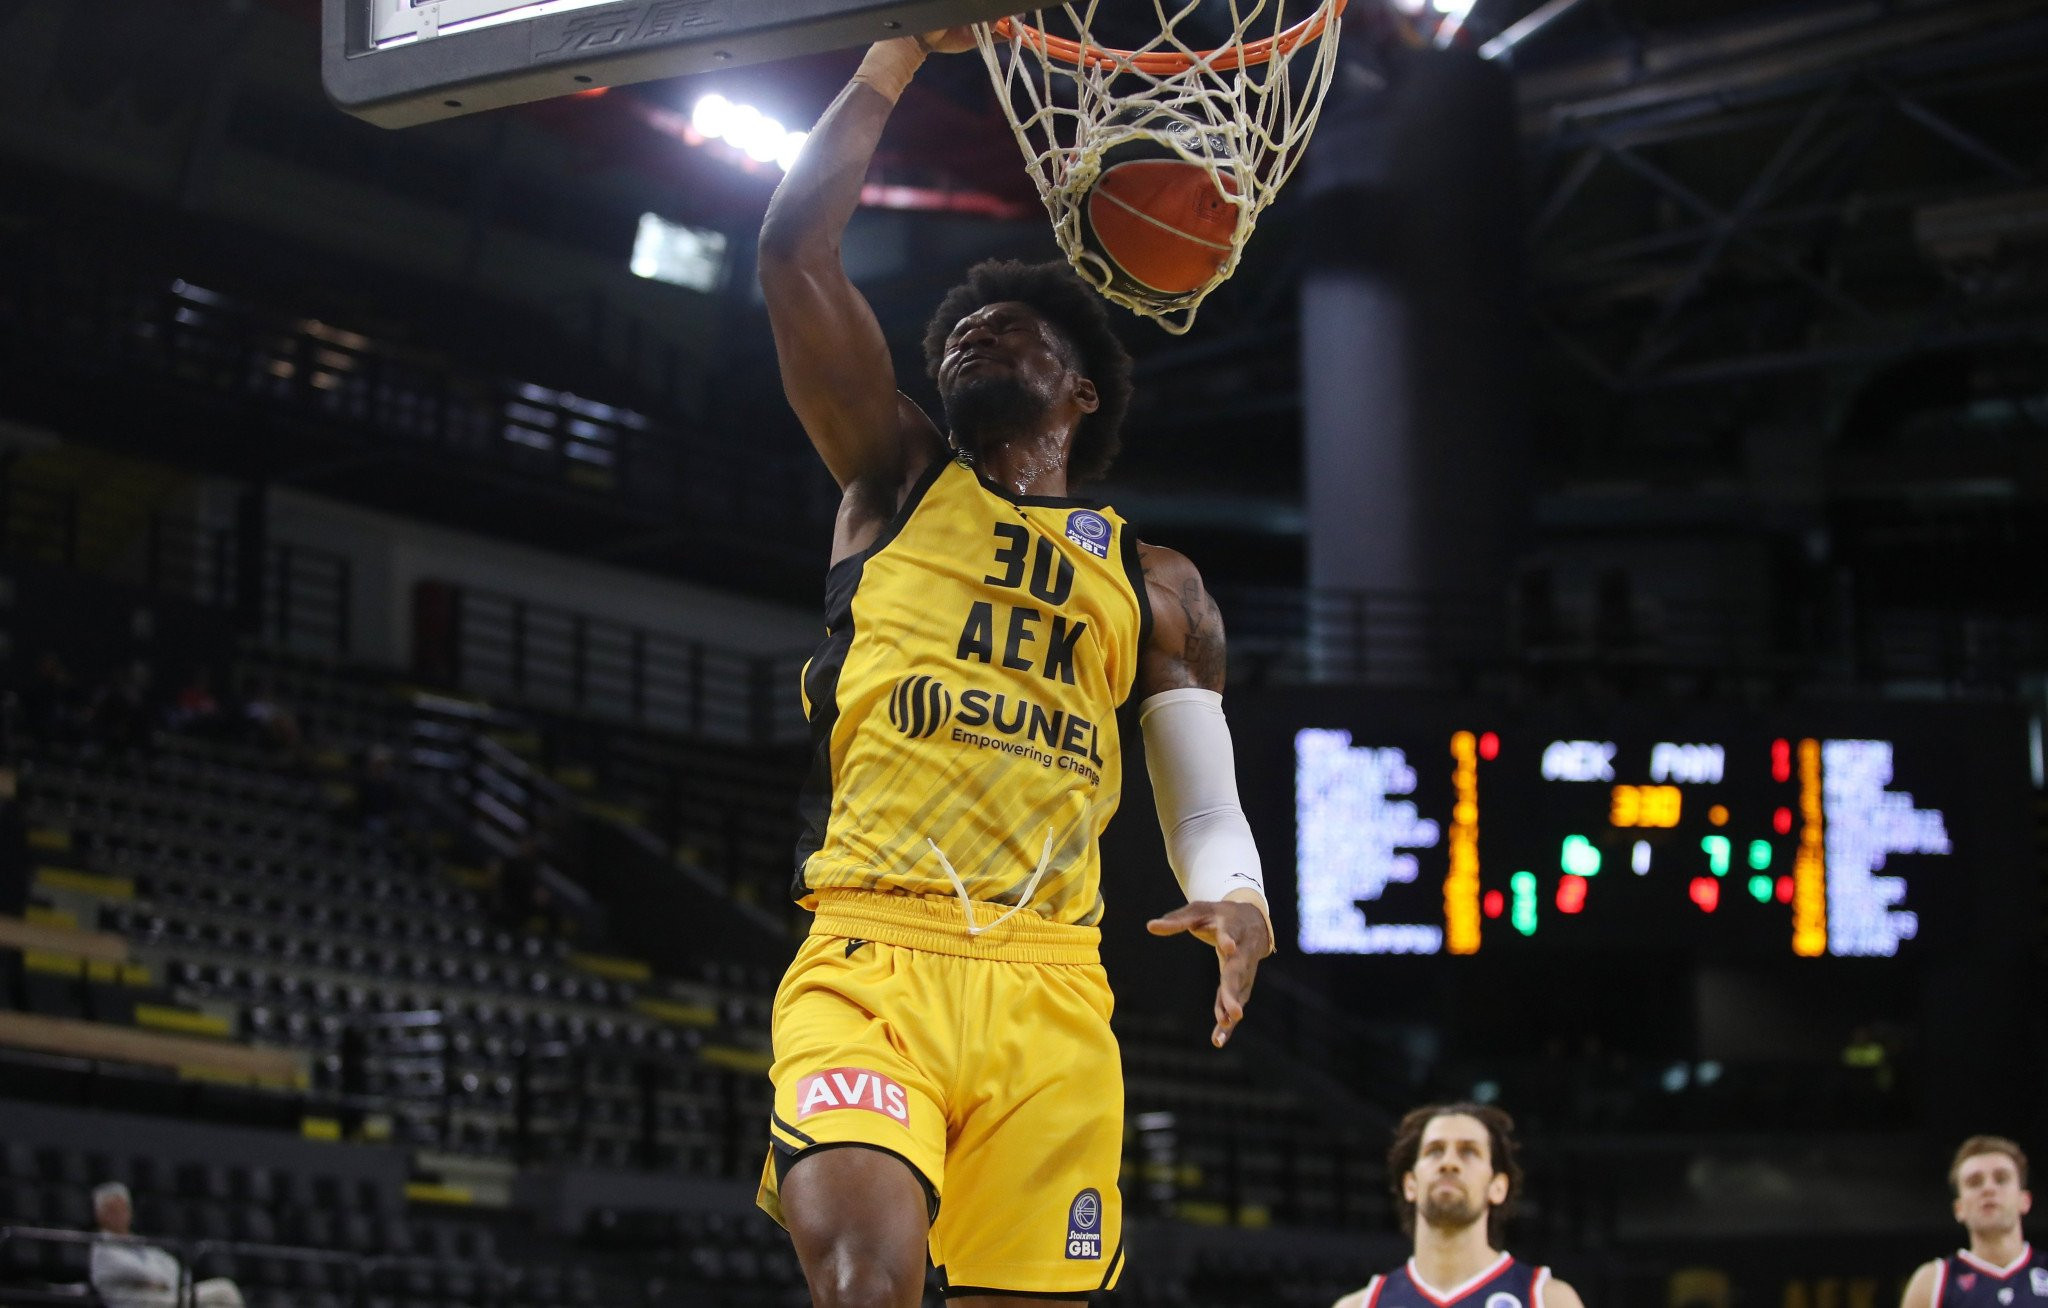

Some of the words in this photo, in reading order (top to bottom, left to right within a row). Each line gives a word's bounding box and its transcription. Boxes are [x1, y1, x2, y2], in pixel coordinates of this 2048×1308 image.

[984, 521, 1075, 606] 30
[956, 600, 1087, 686] AEK
[951, 728, 1053, 768] Empowering
[955, 689, 1104, 768] SUNEL
[800, 1072, 907, 1121] AVIS
[1068, 1240, 1099, 1257] GBL
